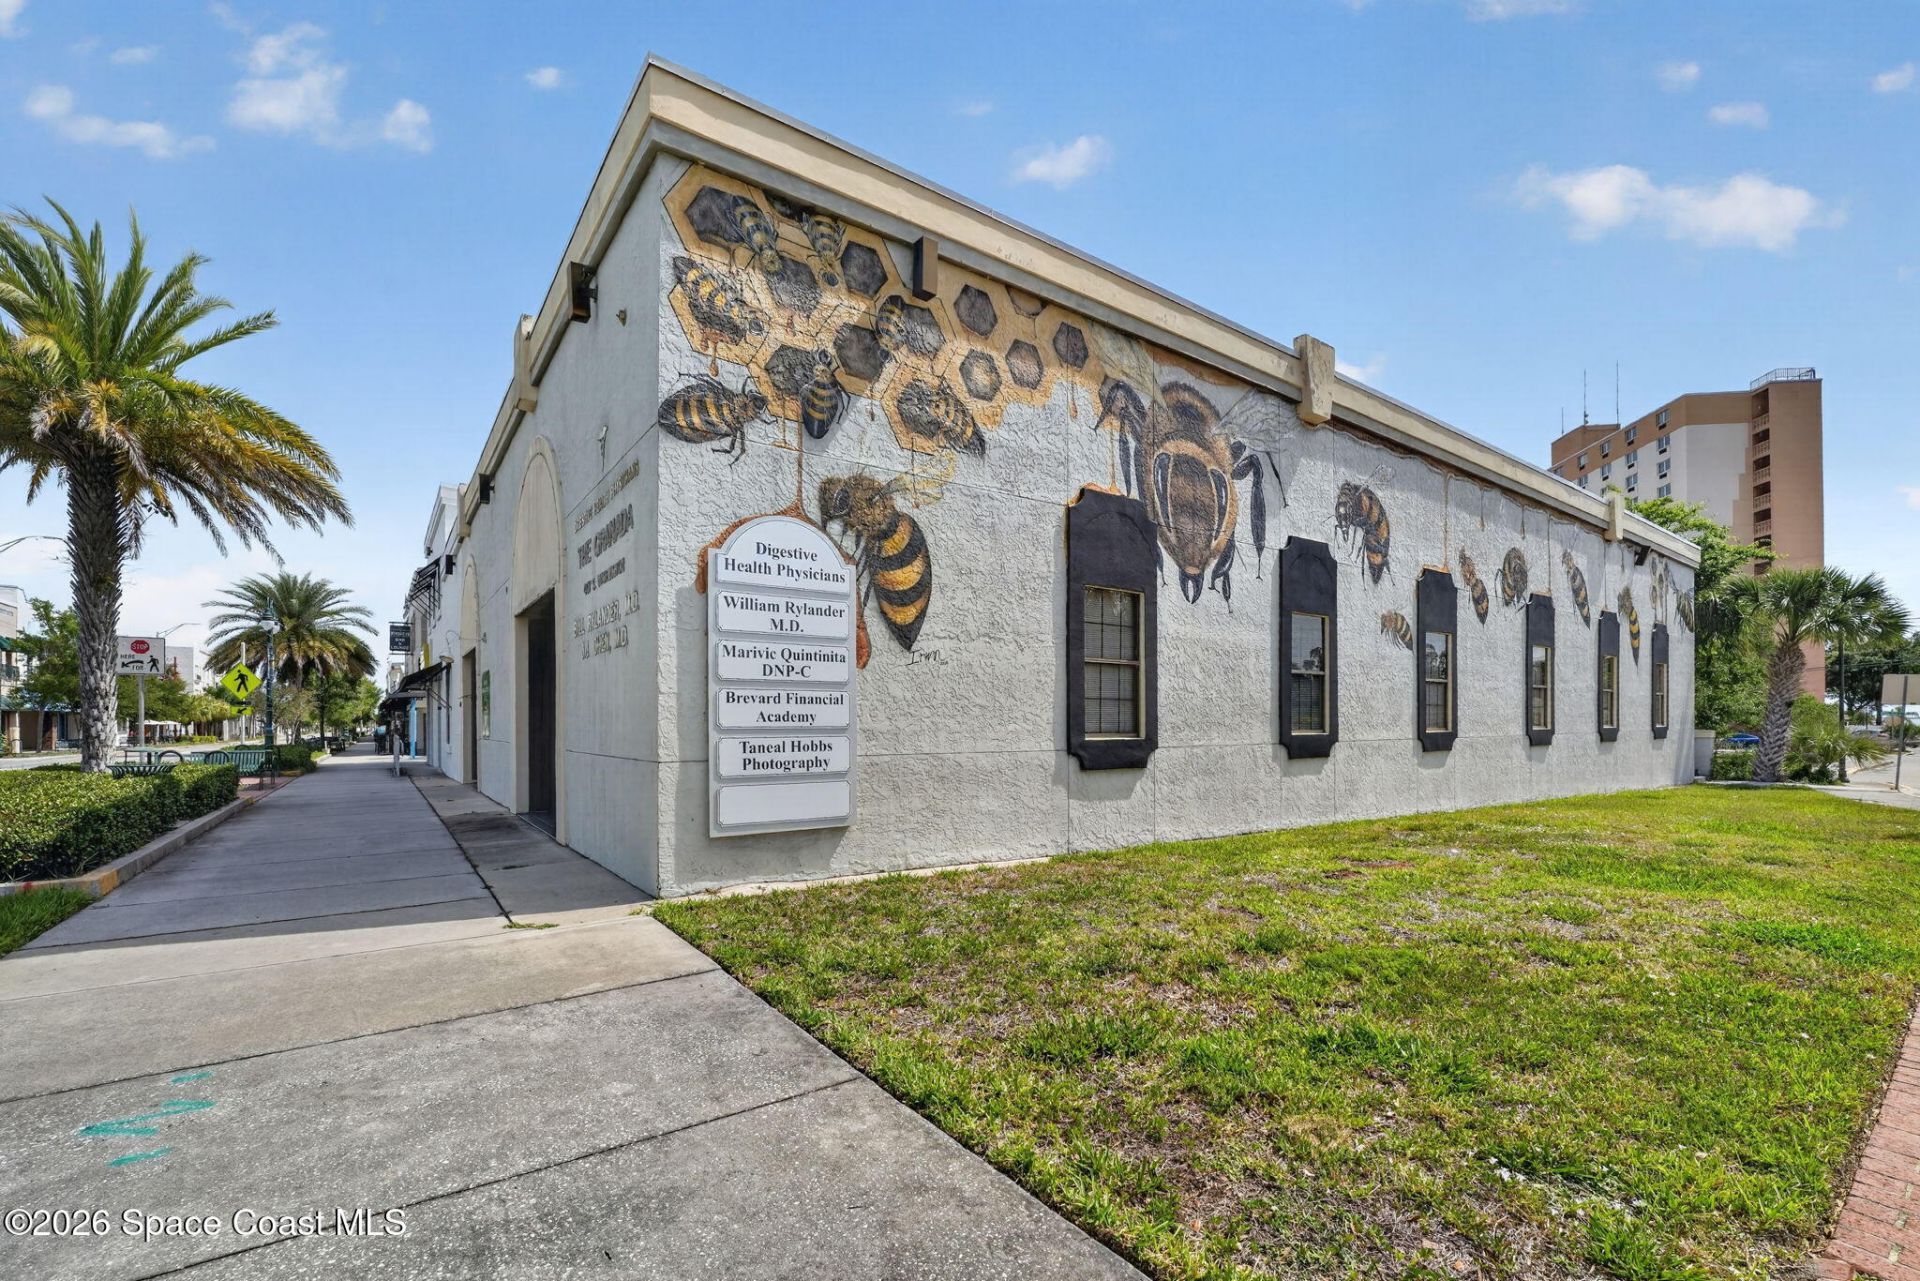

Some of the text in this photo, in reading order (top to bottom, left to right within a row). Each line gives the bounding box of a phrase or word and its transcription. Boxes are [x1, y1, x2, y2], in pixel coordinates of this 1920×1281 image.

[755, 541, 818, 561] Digestive
[724, 557, 846, 583] Health Physicians
[723, 595, 846, 618] William Rylander
[770, 618, 804, 633] M.D.
[722, 644, 847, 663] Marivic Quintinita
[762, 663, 812, 678] DNP-C
[725, 691, 844, 705] Brevard Financial
[756, 710, 816, 725] Academy
[739, 740, 833, 754] Taneal Hobbs
[742, 756, 831, 773] Photography
